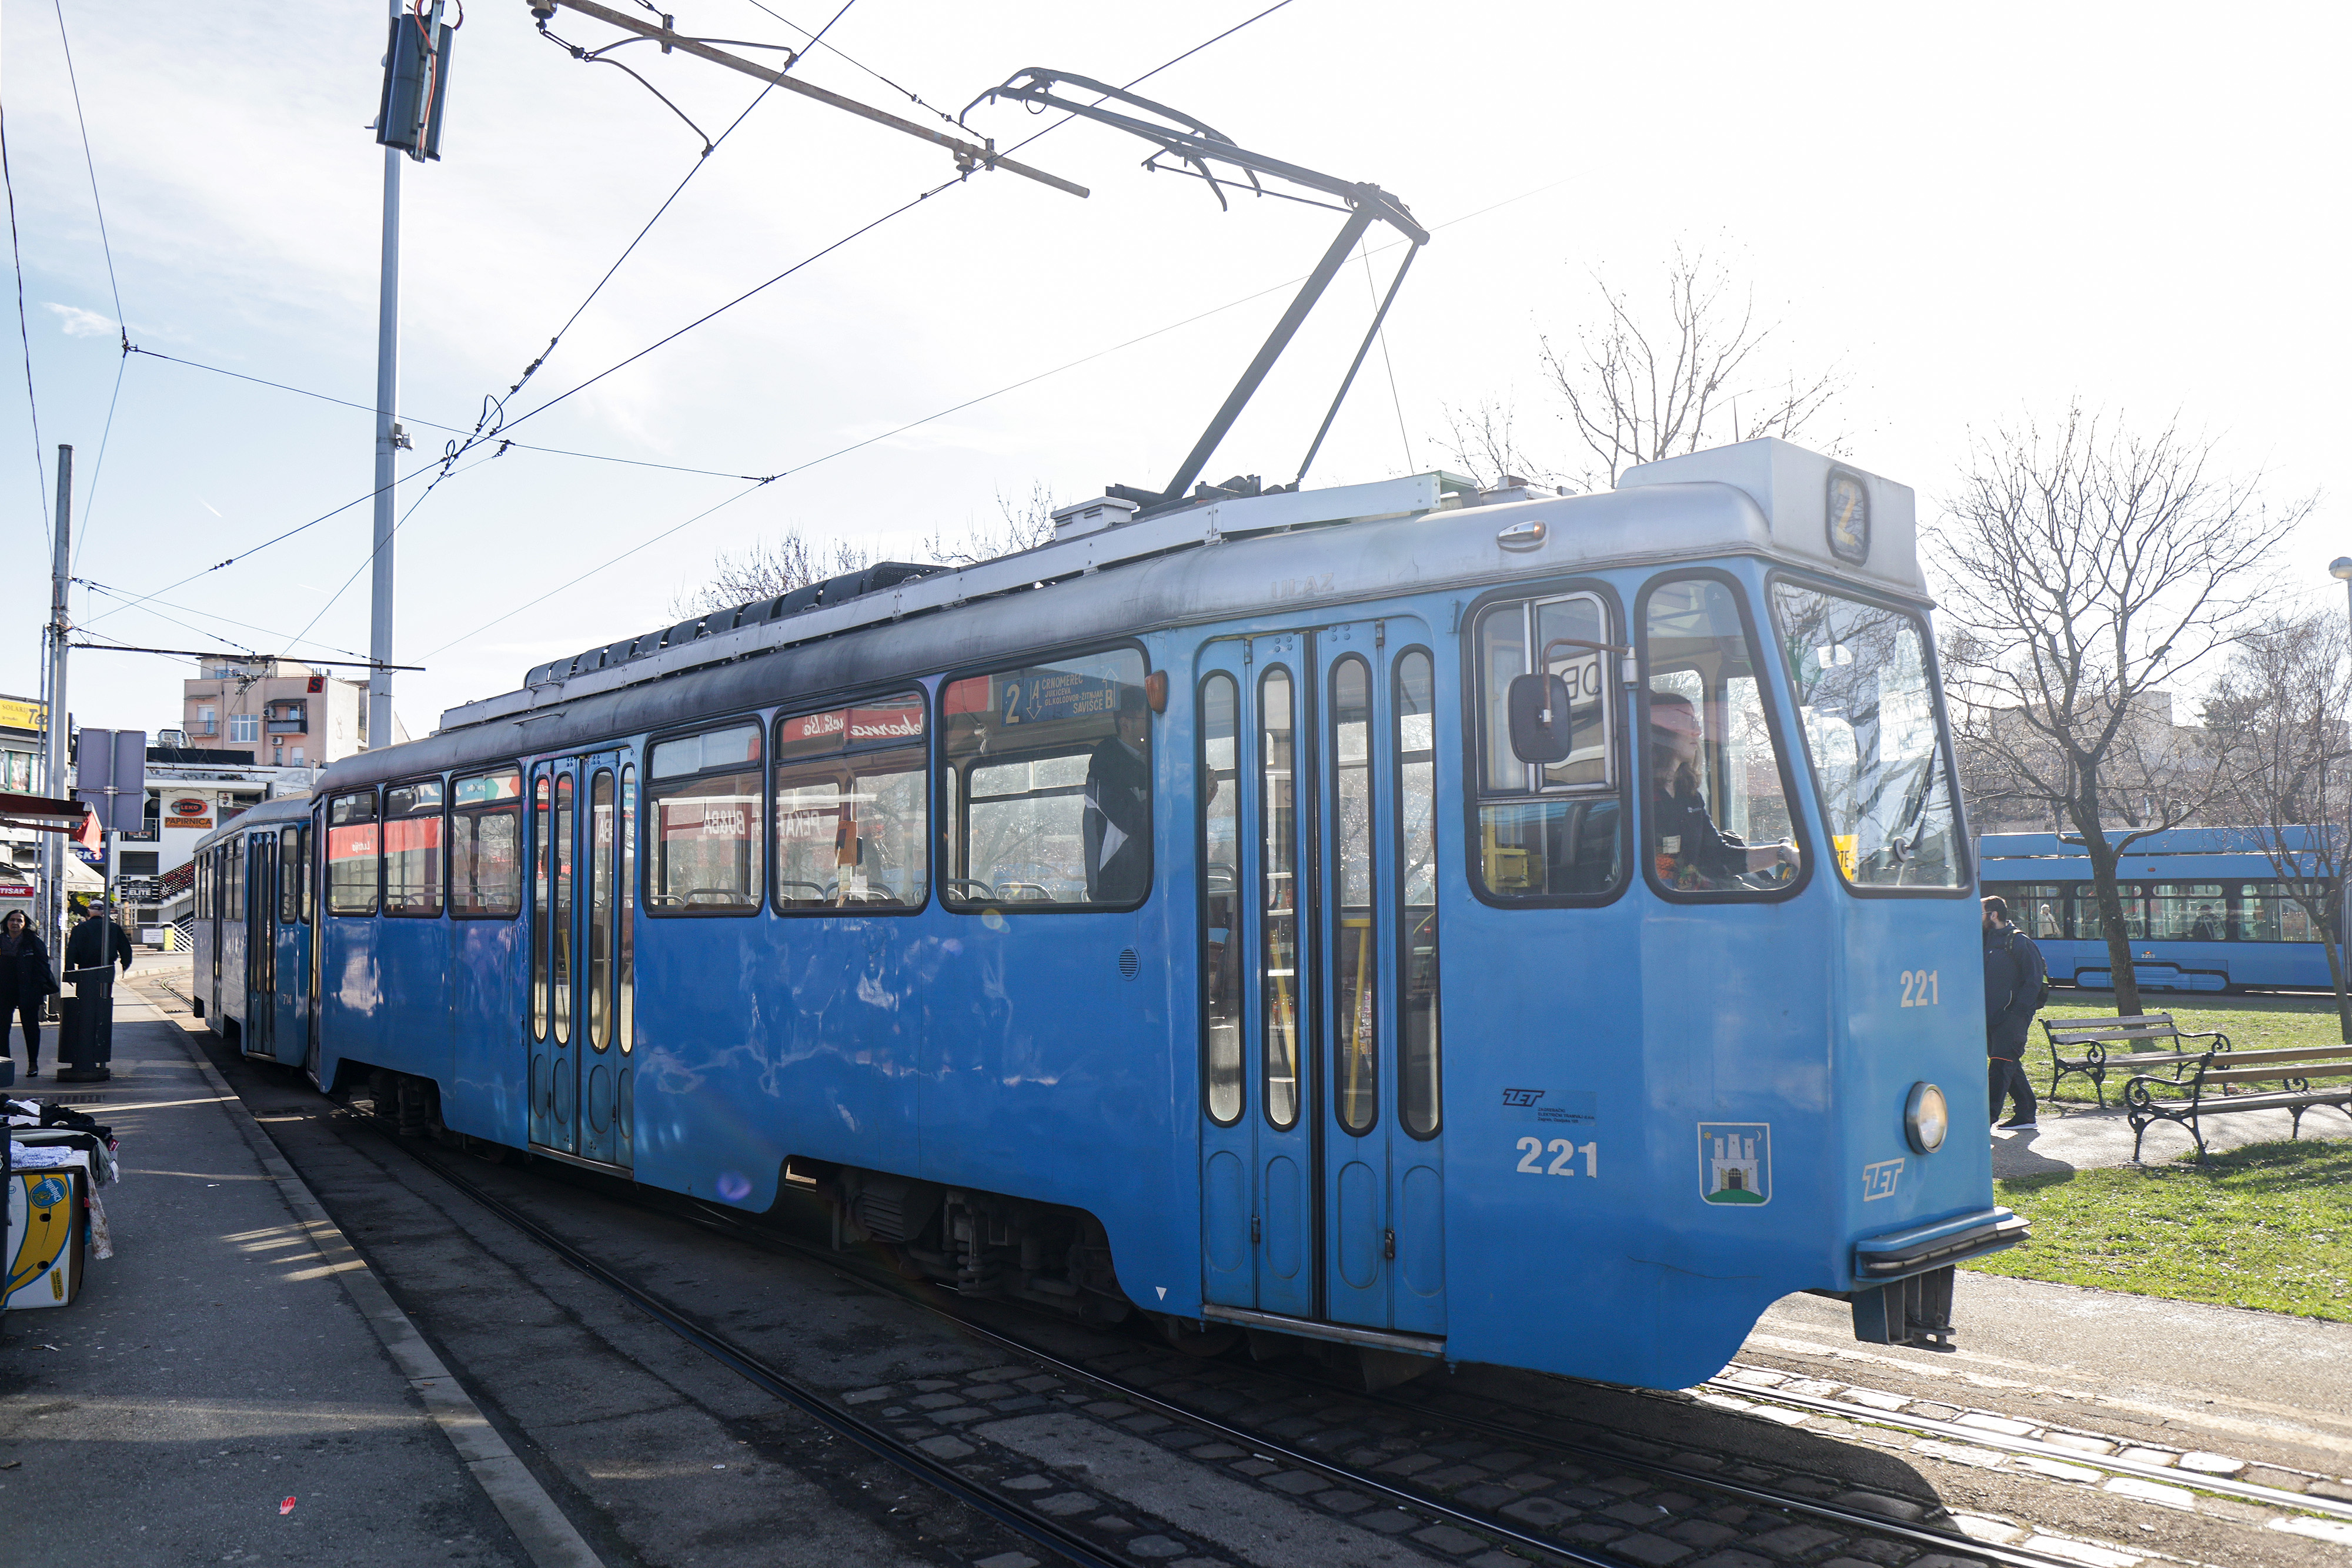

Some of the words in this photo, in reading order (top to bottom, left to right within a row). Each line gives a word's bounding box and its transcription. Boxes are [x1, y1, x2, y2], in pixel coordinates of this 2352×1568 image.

[1837, 480, 1856, 546] 2
[1271, 573, 1334, 599] ULAZ
[310, 678, 321, 691] S
[1032, 680, 1040, 700] A
[1042, 673, 1083, 690] ČRNOMEREC
[1006, 684, 1020, 723] 2
[1073, 698, 1102, 714] SAVIŠĆE
[1105, 689, 1113, 709] B
[1900, 969, 1939, 1008] 221
[1502, 1088, 1545, 1107] ZET
[1516, 1136, 1596, 1178] 221
[45, 1178, 62, 1202] Chiquita
[1862, 1158, 1905, 1202] ZET
